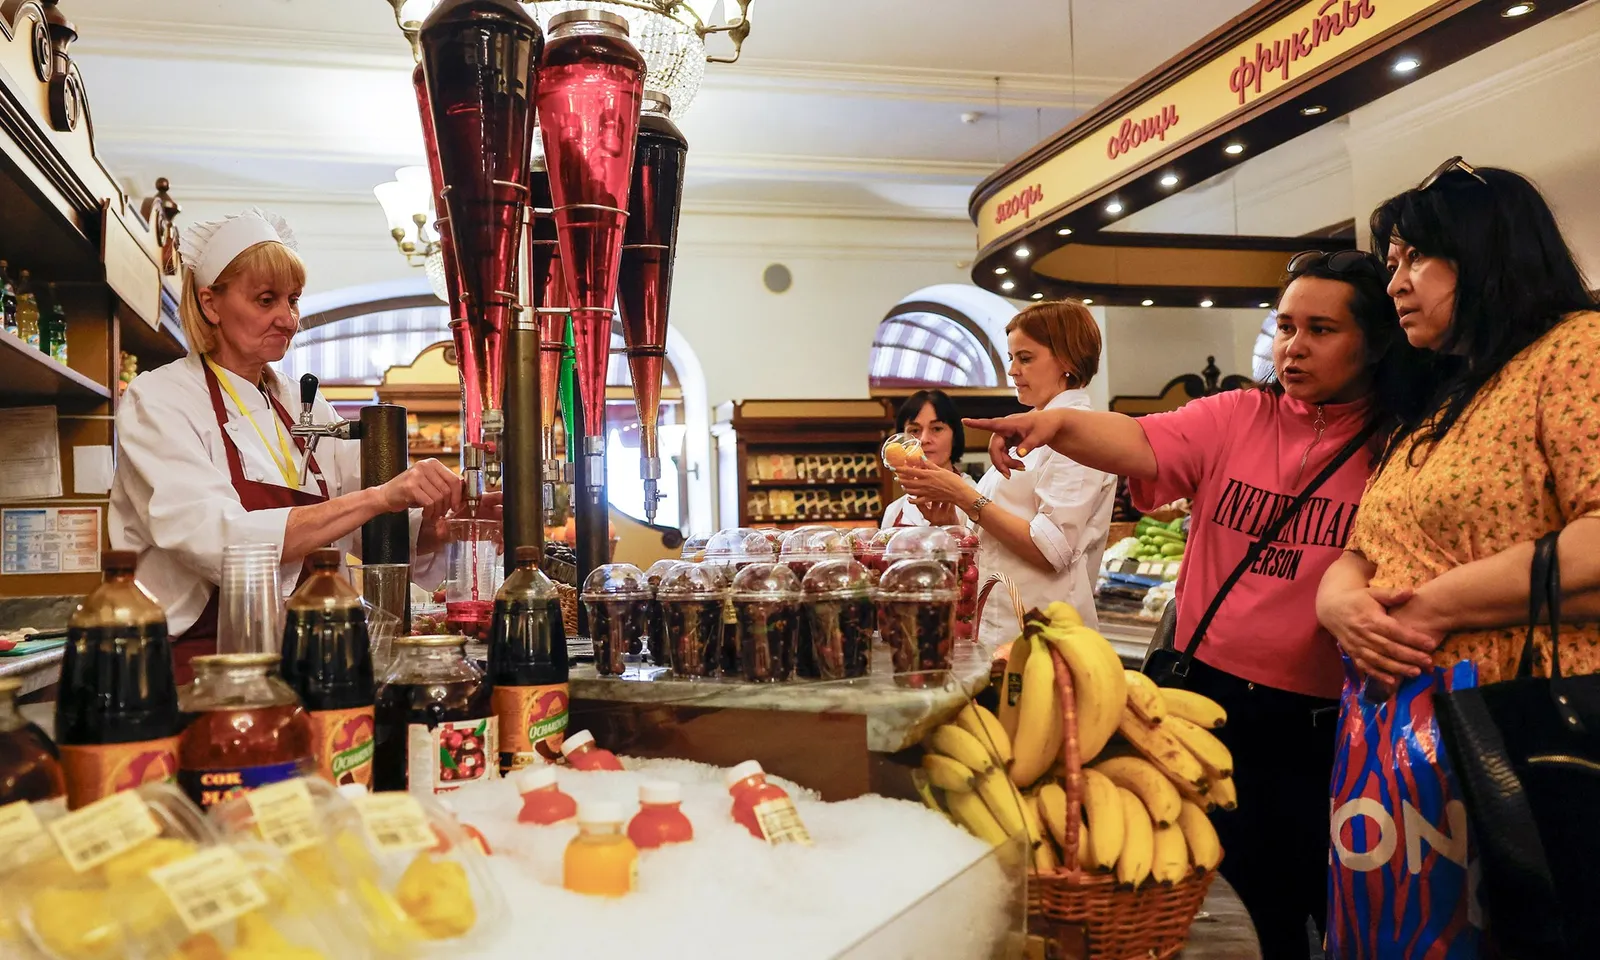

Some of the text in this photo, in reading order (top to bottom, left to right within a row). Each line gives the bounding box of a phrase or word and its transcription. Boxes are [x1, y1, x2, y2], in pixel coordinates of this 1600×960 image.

[1230, 0, 1375, 105] фрукты
[1107, 104, 1179, 160] овощи
[995, 184, 1043, 224] ягоды
[201, 772, 243, 785] СОК
[1329, 797, 1467, 874] ON
